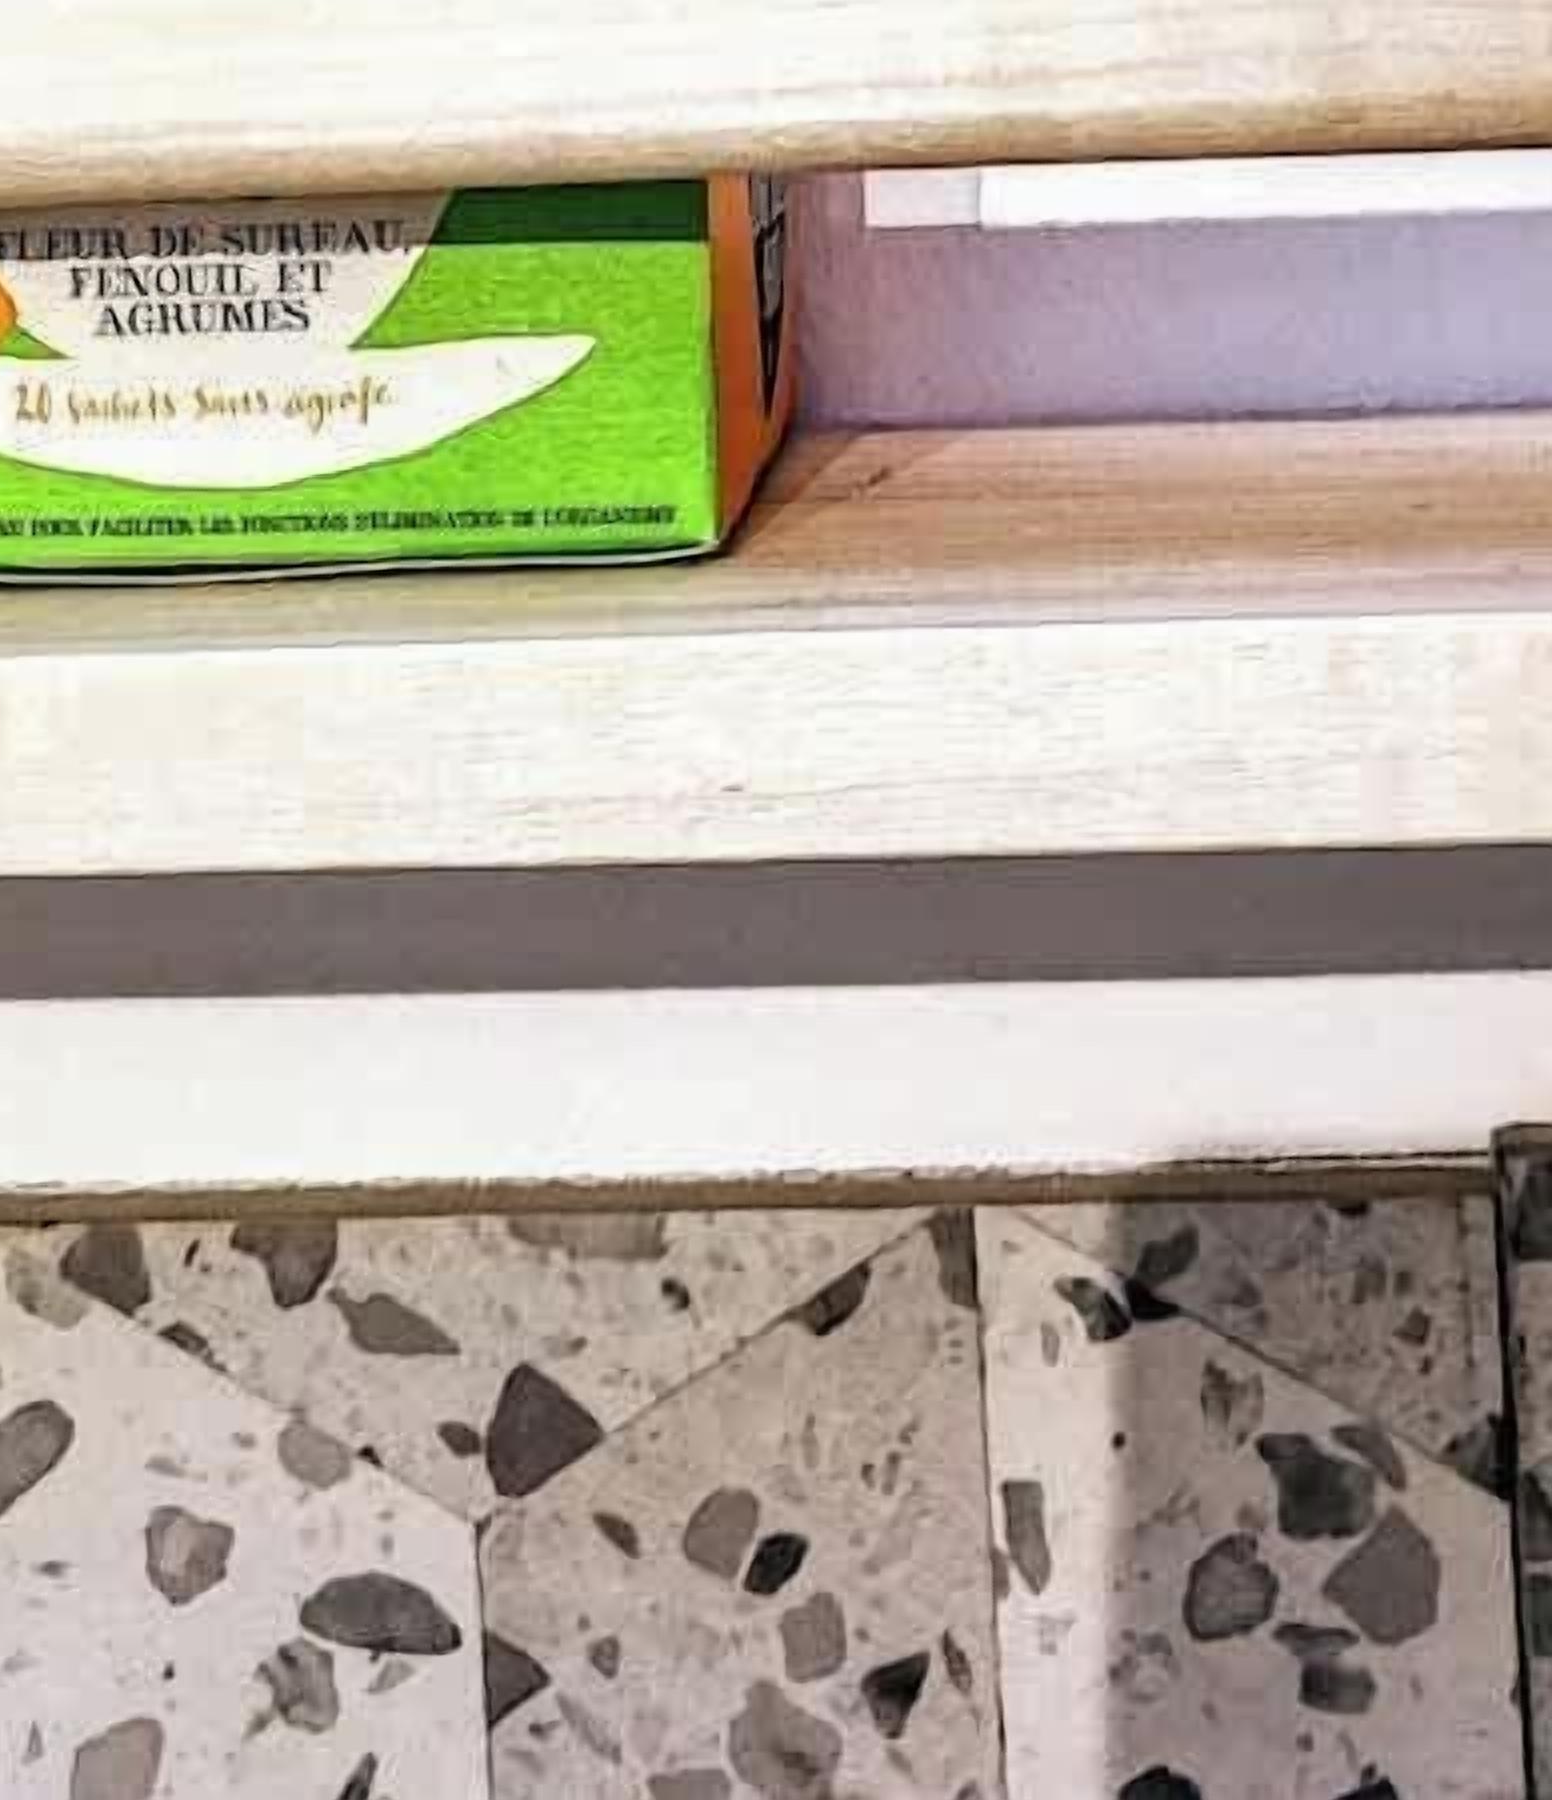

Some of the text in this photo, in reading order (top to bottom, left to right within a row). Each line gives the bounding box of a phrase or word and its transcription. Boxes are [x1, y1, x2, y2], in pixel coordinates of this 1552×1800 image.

[150, 223, 199, 258] DE
[68, 260, 334, 299] FENOUIL ET
[93, 299, 313, 337] AGRUMES
